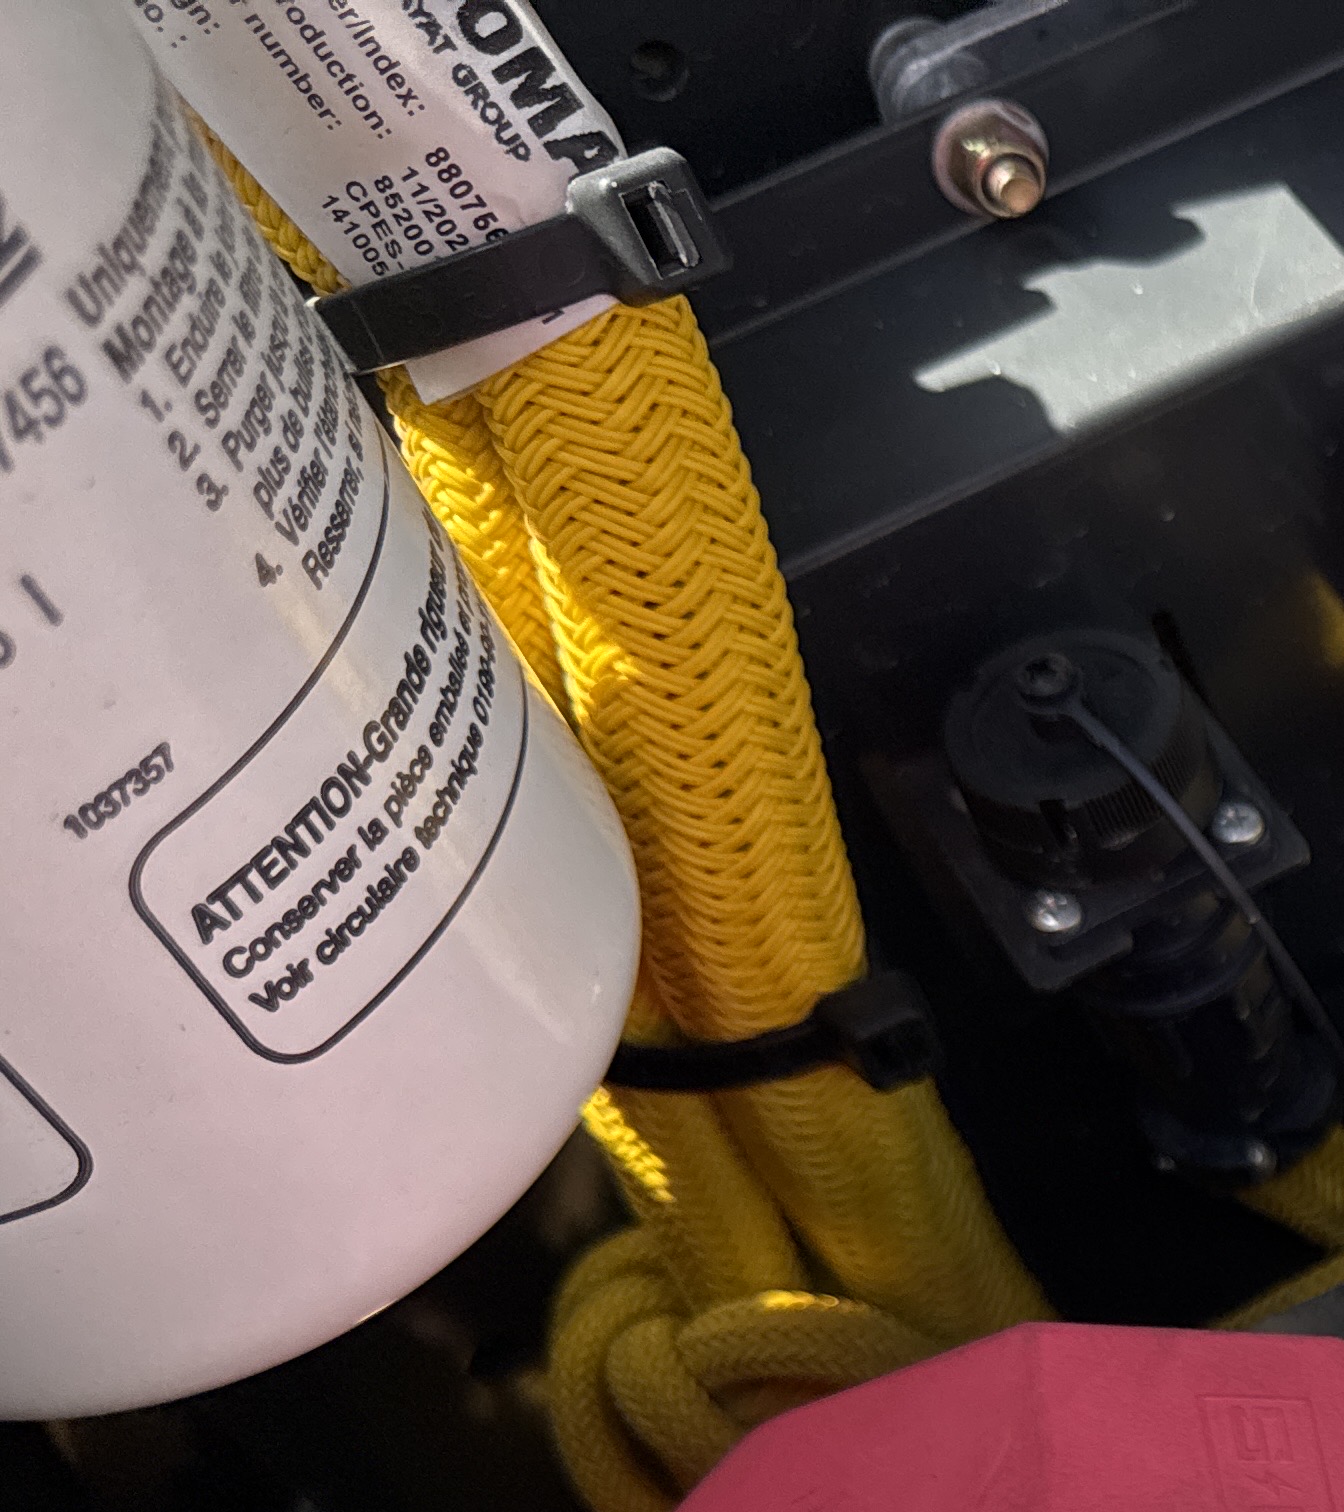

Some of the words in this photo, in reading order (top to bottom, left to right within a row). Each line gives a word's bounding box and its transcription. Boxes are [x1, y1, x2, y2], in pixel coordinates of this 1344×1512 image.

[244, 13, 342, 130] number:
[451, 63, 531, 162] GROUP
[322, 195, 389, 277] 141005
[101, 223, 197, 386] Montage
[164, 278, 226, 389] Enduire
[194, 335, 247, 430] Serrer
[221, 371, 276, 473] Purger
[253, 446, 291, 521] plus
[280, 409, 305, 453] de
[222, 845, 362, 978] Conserver
[357, 818, 389, 852] la
[384, 744, 434, 829] pièce
[248, 958, 315, 1013] Voir
[315, 846, 420, 966] circulaire
[414, 722, 484, 849] technique
